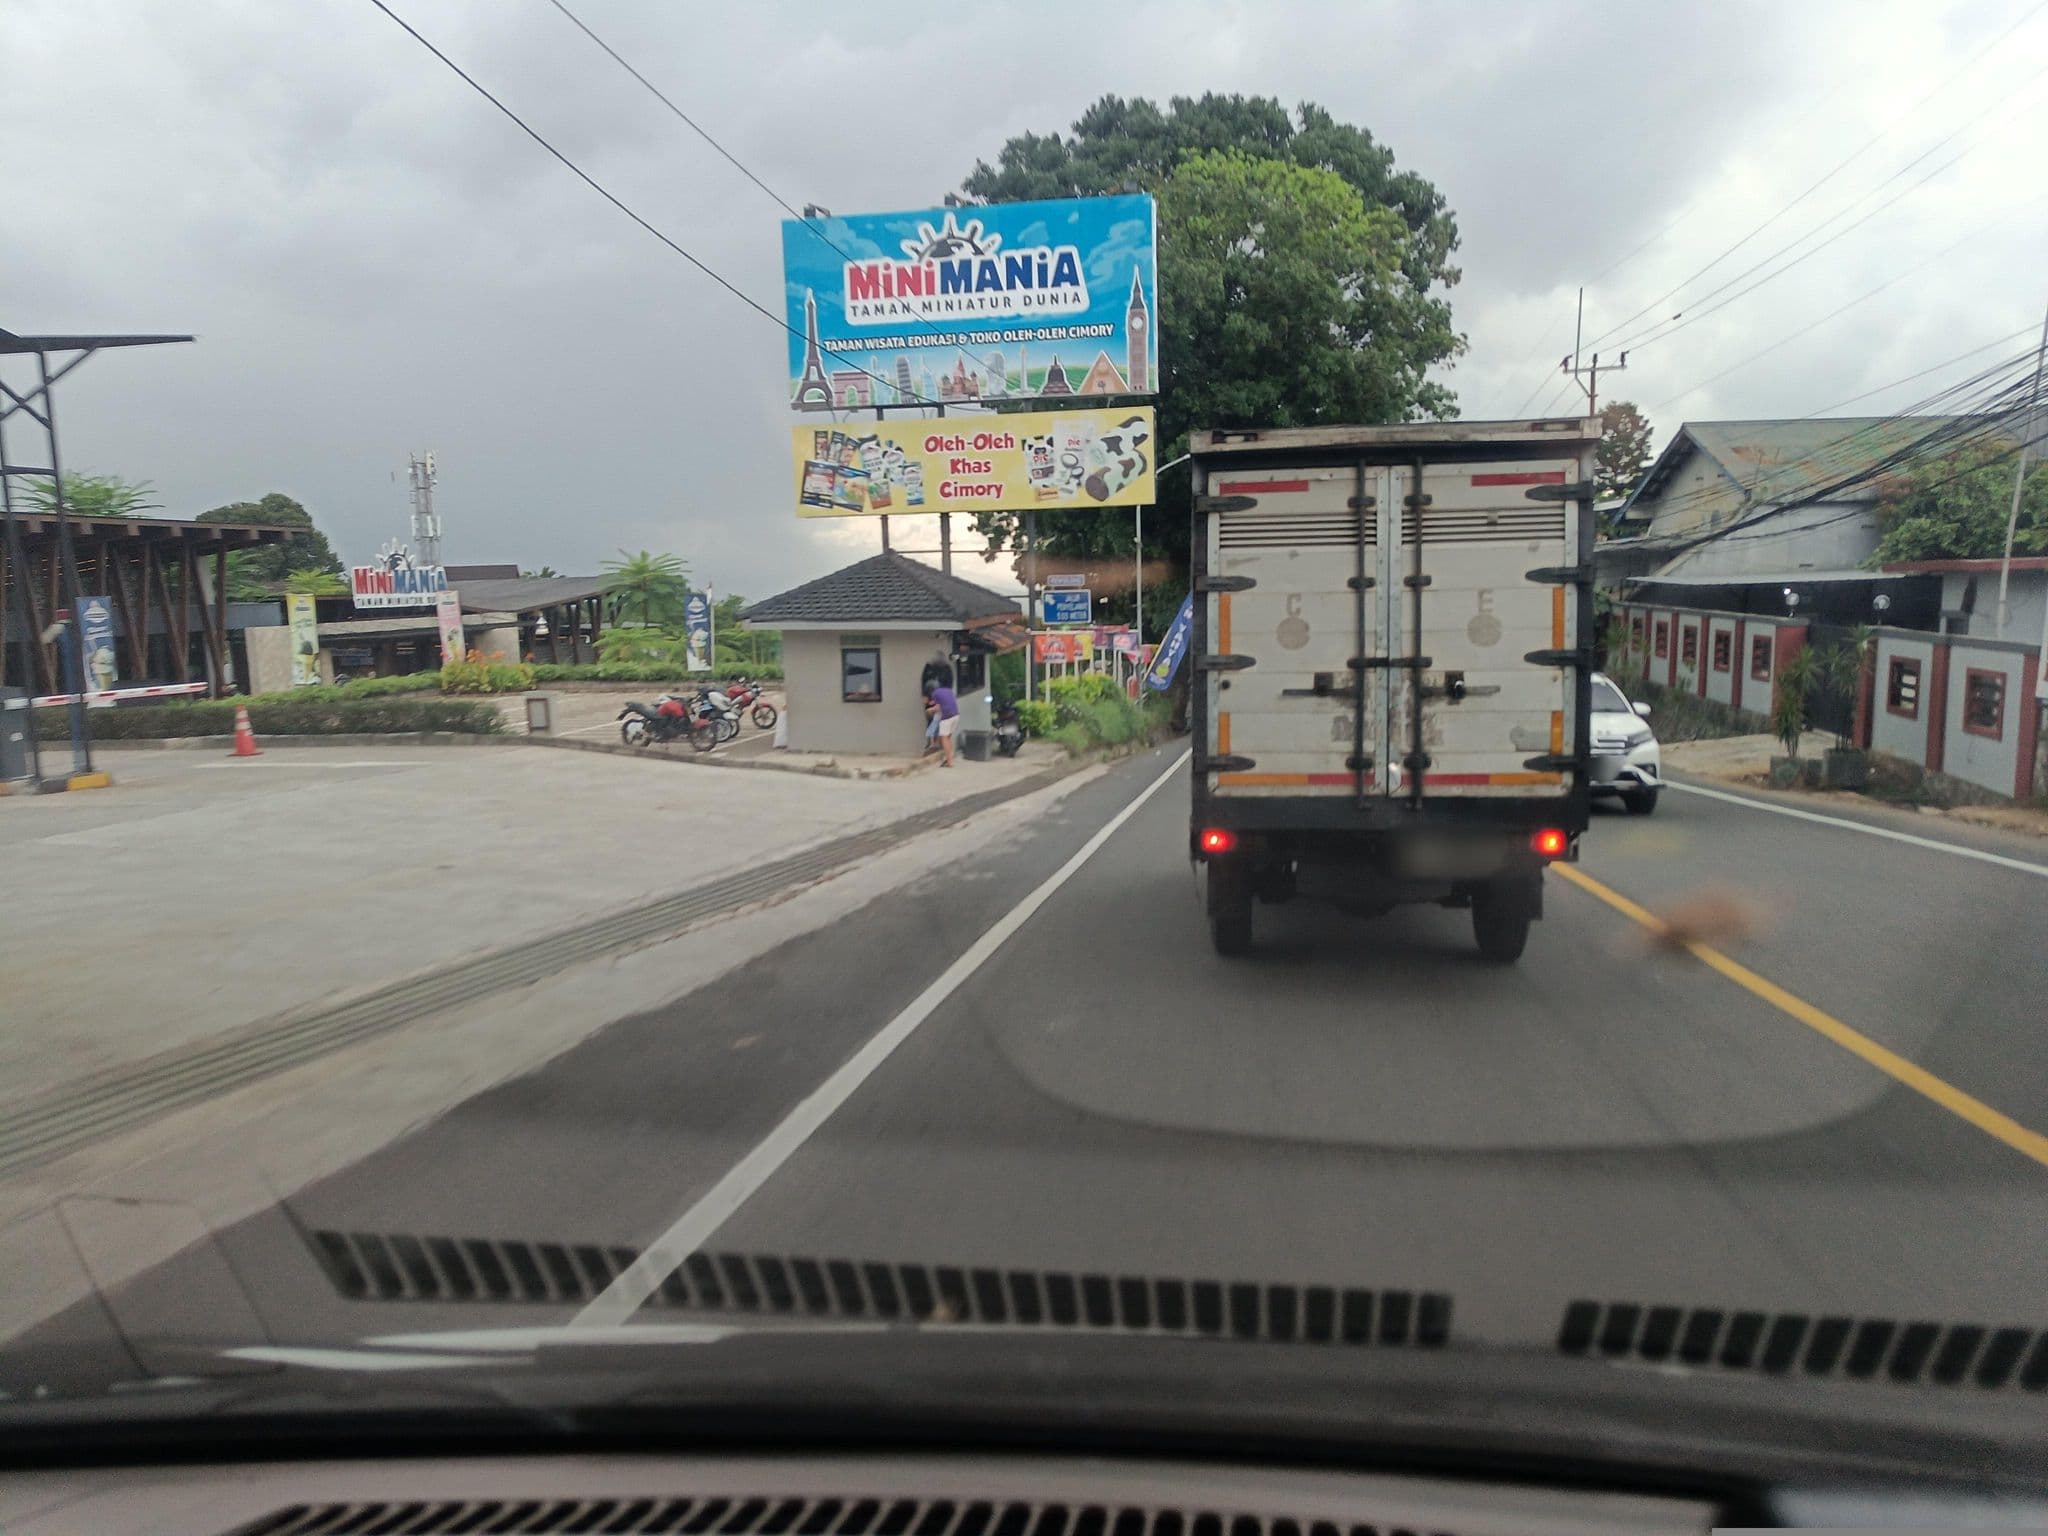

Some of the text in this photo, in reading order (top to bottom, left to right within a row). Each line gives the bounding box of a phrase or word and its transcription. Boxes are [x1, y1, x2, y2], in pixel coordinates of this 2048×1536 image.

[850, 291, 1083, 318] TAMAN MINIATUR DUNIA
[824, 337, 864, 353] TAMAN
[865, 335, 906, 351] WISATA
[906, 333, 957, 349] EDUKASI
[969, 330, 1000, 345] TOKO
[1003, 326, 1068, 343] OLEH-OLEH
[1068, 323, 1116, 341] CIMORY
[924, 433, 1015, 453] Oleh-Oleh
[949, 458, 992, 476] Khas
[939, 480, 1005, 499] Cimory
